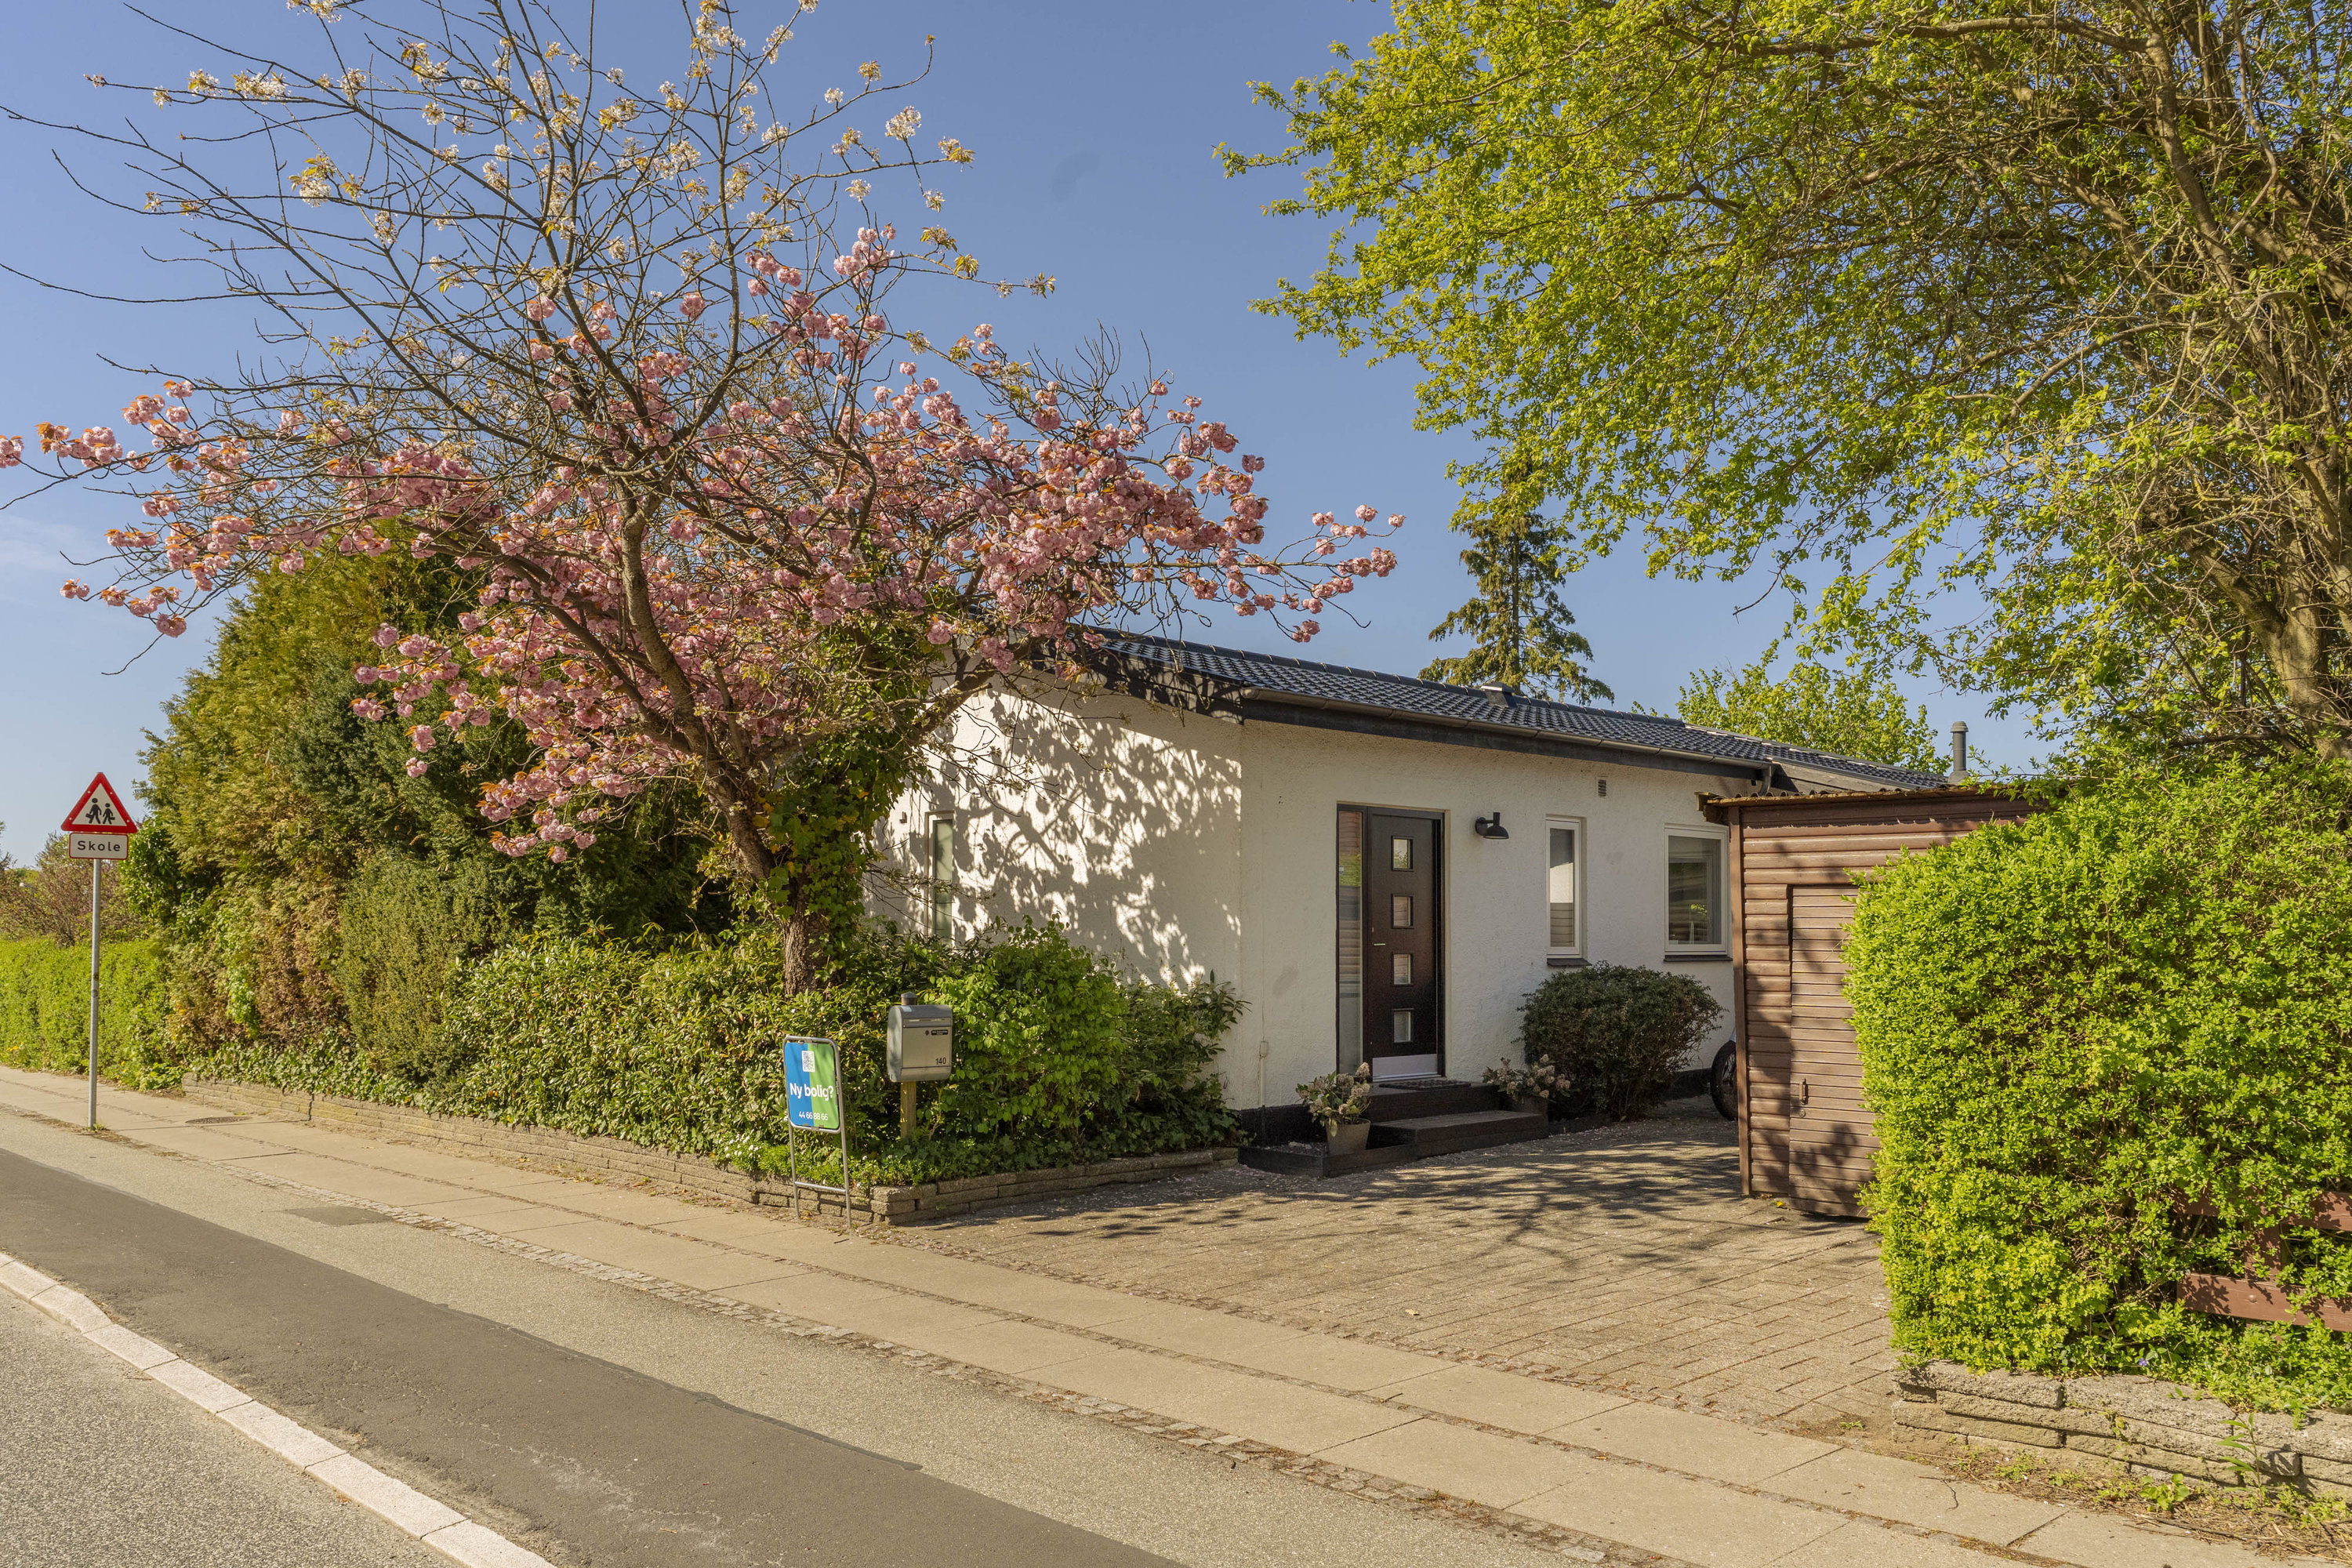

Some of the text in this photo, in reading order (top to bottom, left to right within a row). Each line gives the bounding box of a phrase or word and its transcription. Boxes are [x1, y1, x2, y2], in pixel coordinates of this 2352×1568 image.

[77, 840, 121, 851] Skole
[789, 1083, 833, 1101] Ny bolig?
